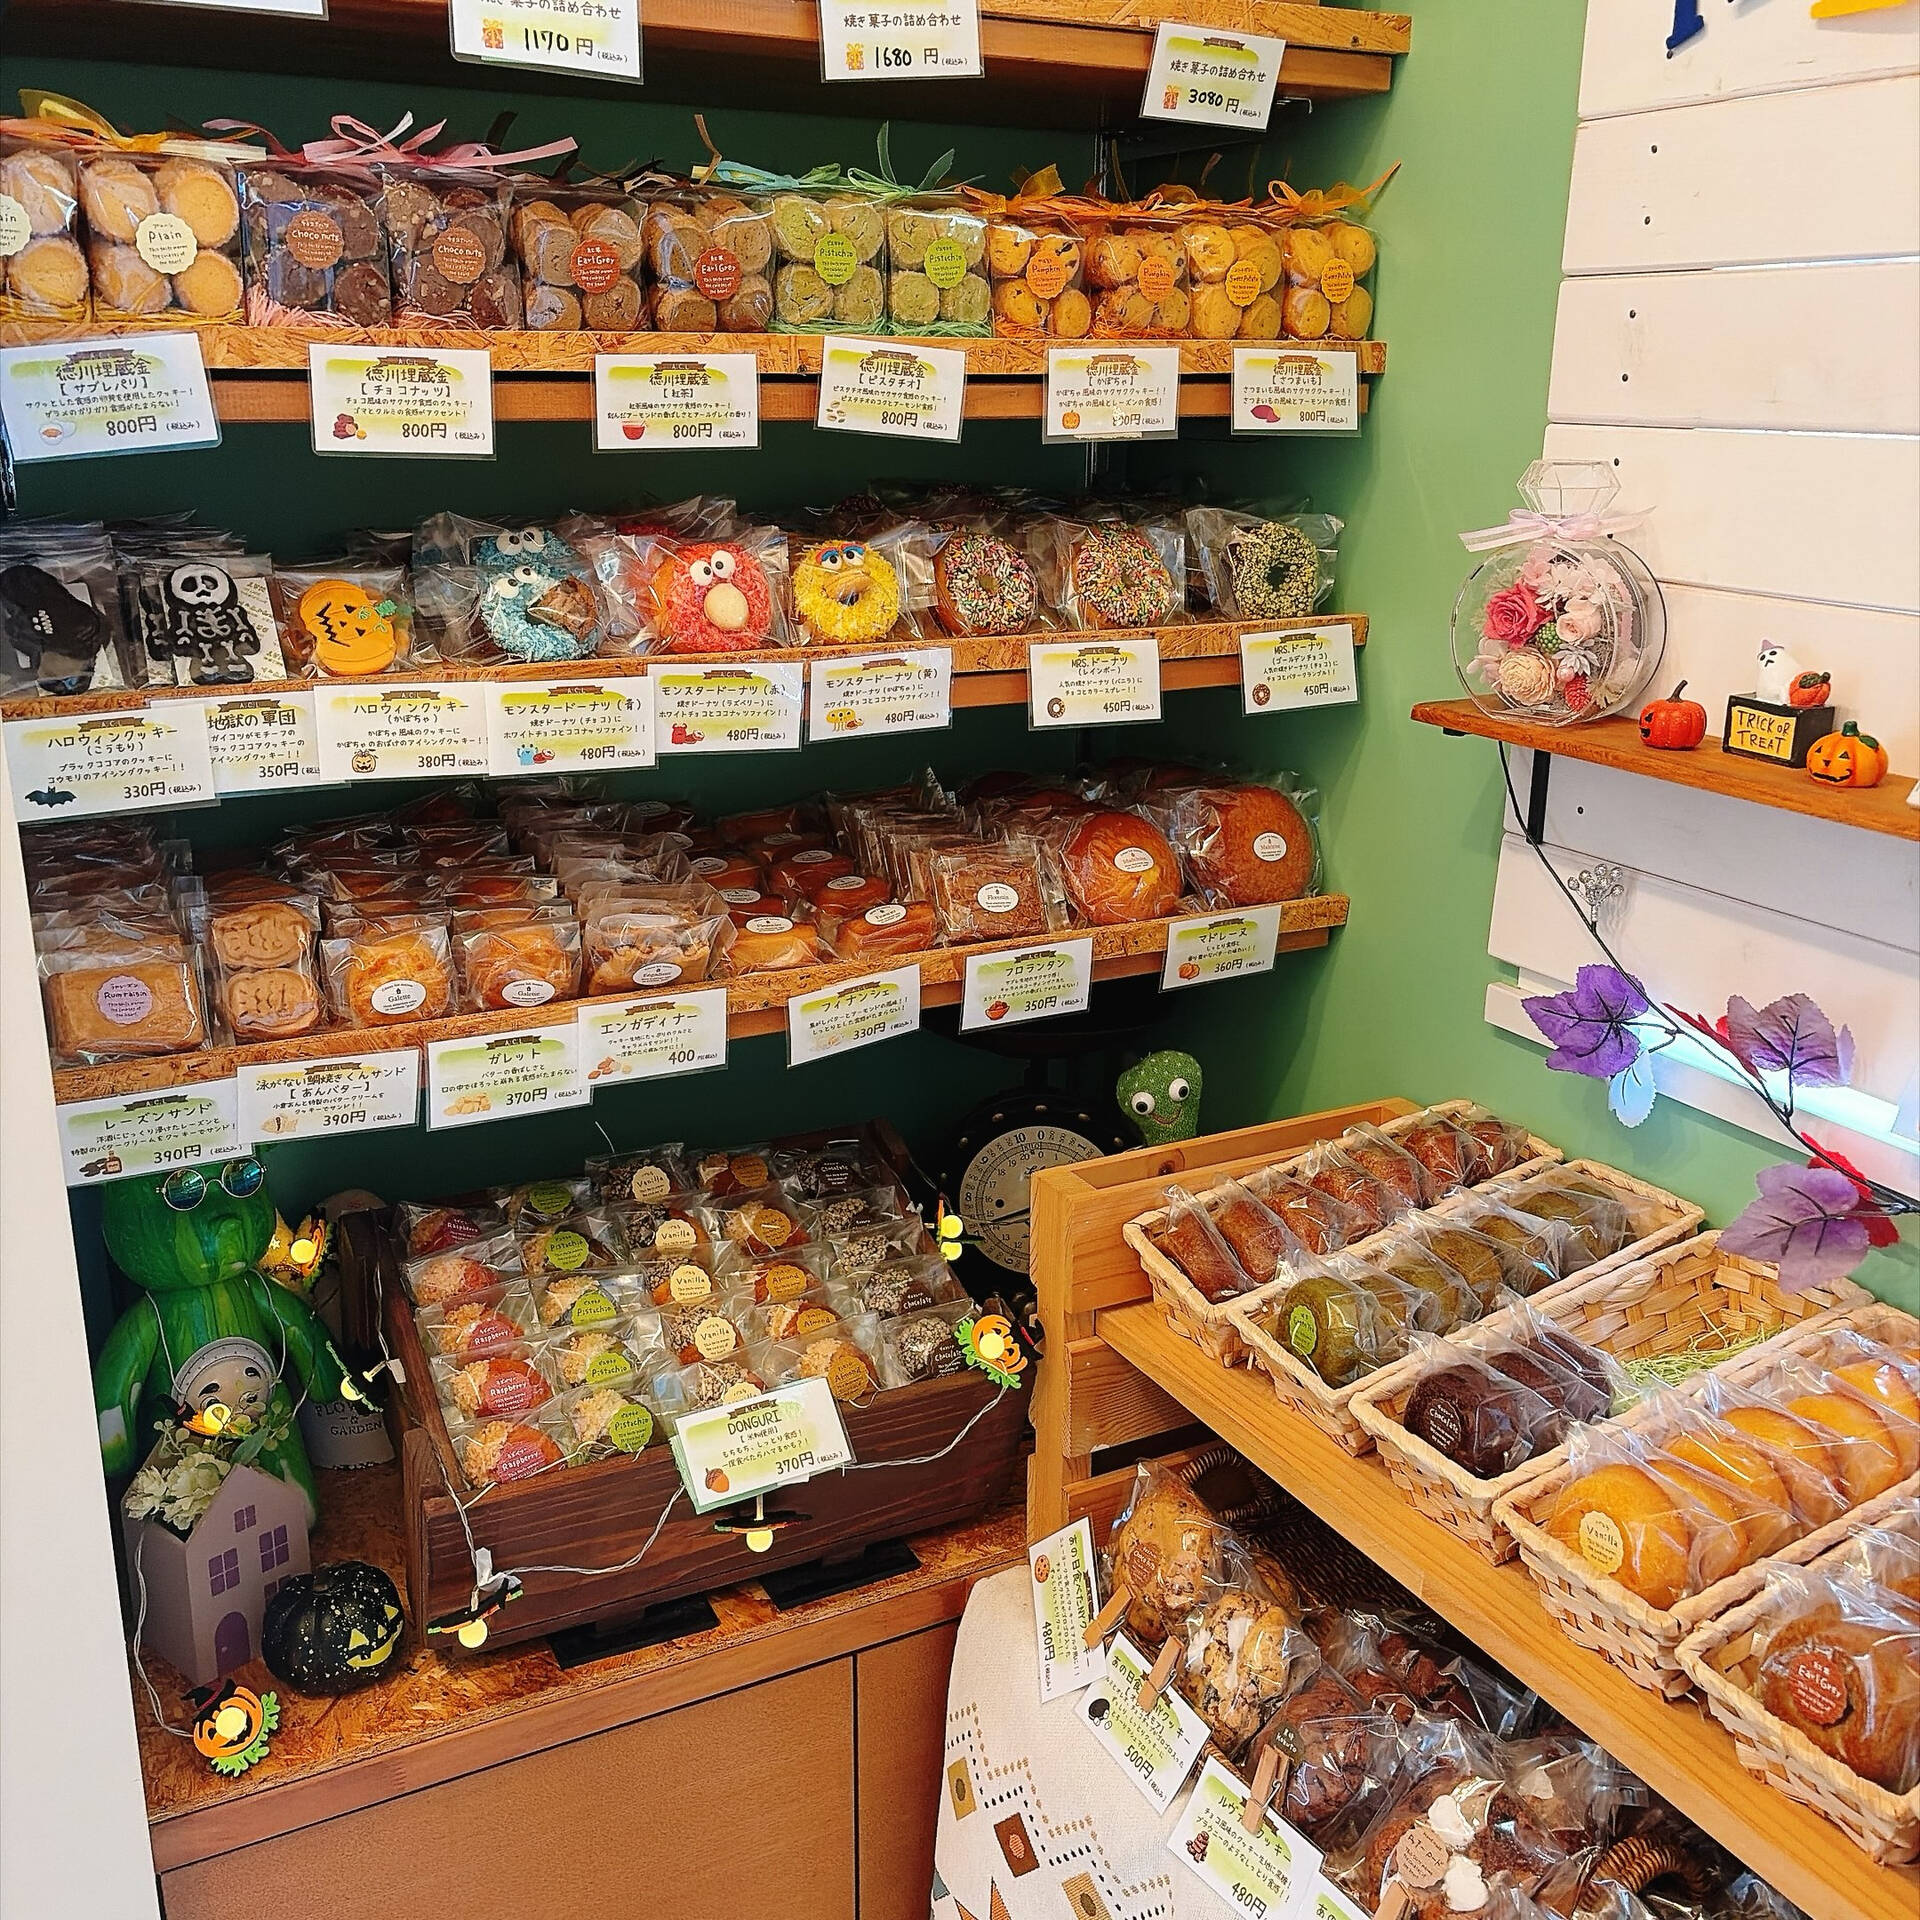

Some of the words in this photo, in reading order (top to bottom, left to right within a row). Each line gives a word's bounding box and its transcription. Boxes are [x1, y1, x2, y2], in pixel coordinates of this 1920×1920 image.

[844, 13, 961, 29] 焼き菓子の詰め合わせ
[1170, 59, 1267, 83] 焼き菓子の詰め合わせ
[56, 358, 152, 381] 徳川埋蔵金
[366, 367, 451, 384] 徳川埋蔵金
[859, 358, 929, 379] 徳川埋蔵金
[649, 373, 713, 386] 徳川埋蔵金
[881, 411, 919, 428] 800円
[1299, 410, 1327, 422] 800円
[106, 415, 157, 437] 800円
[402, 422, 447, 439] 800円
[673, 422, 713, 439] 800円
[1303, 682, 1329, 696] 450円
[354, 701, 469, 714] ハロウィンクッキー
[1103, 700, 1131, 713] 450円
[207, 709, 297, 731] 地獄の軍団
[885, 710, 914, 724] 480円
[1736, 709, 1775, 734] TRICK
[1777, 721, 1792, 736] OR
[48, 726, 178, 748] ハロウィンクッキー
[727, 728, 759, 741] 480円
[1736, 729, 1787, 756] TREAT
[208, 739, 305, 753] ラックココアクッキーの
[580, 745, 616, 760] 480円
[418, 753, 456, 768] 380円
[259, 762, 299, 778] 350円
[123, 781, 166, 799] 330円
[1198, 928, 1248, 943] マドレーヌ
[1006, 959, 1066, 977] フロランタン
[1214, 958, 1243, 973] 360円
[821, 989, 890, 1012] フィナンシェ
[1024, 995, 1057, 1012] 350円
[600, 1013, 698, 1035] エンガディナー
[853, 1021, 887, 1041] 330円
[488, 1049, 541, 1065] ガレット
[506, 1087, 547, 1105] 370円
[105, 1102, 213, 1130] レーズンサンド
[323, 1110, 366, 1127] 390円
[153, 1143, 202, 1165] 390円
[727, 1410, 782, 1435] DONGURI
[775, 1451, 815, 1475] 370円
[1041, 1621, 1056, 1662] 480円
[1124, 1744, 1155, 1780] 500円
[1231, 1882, 1268, 1919] 480円
